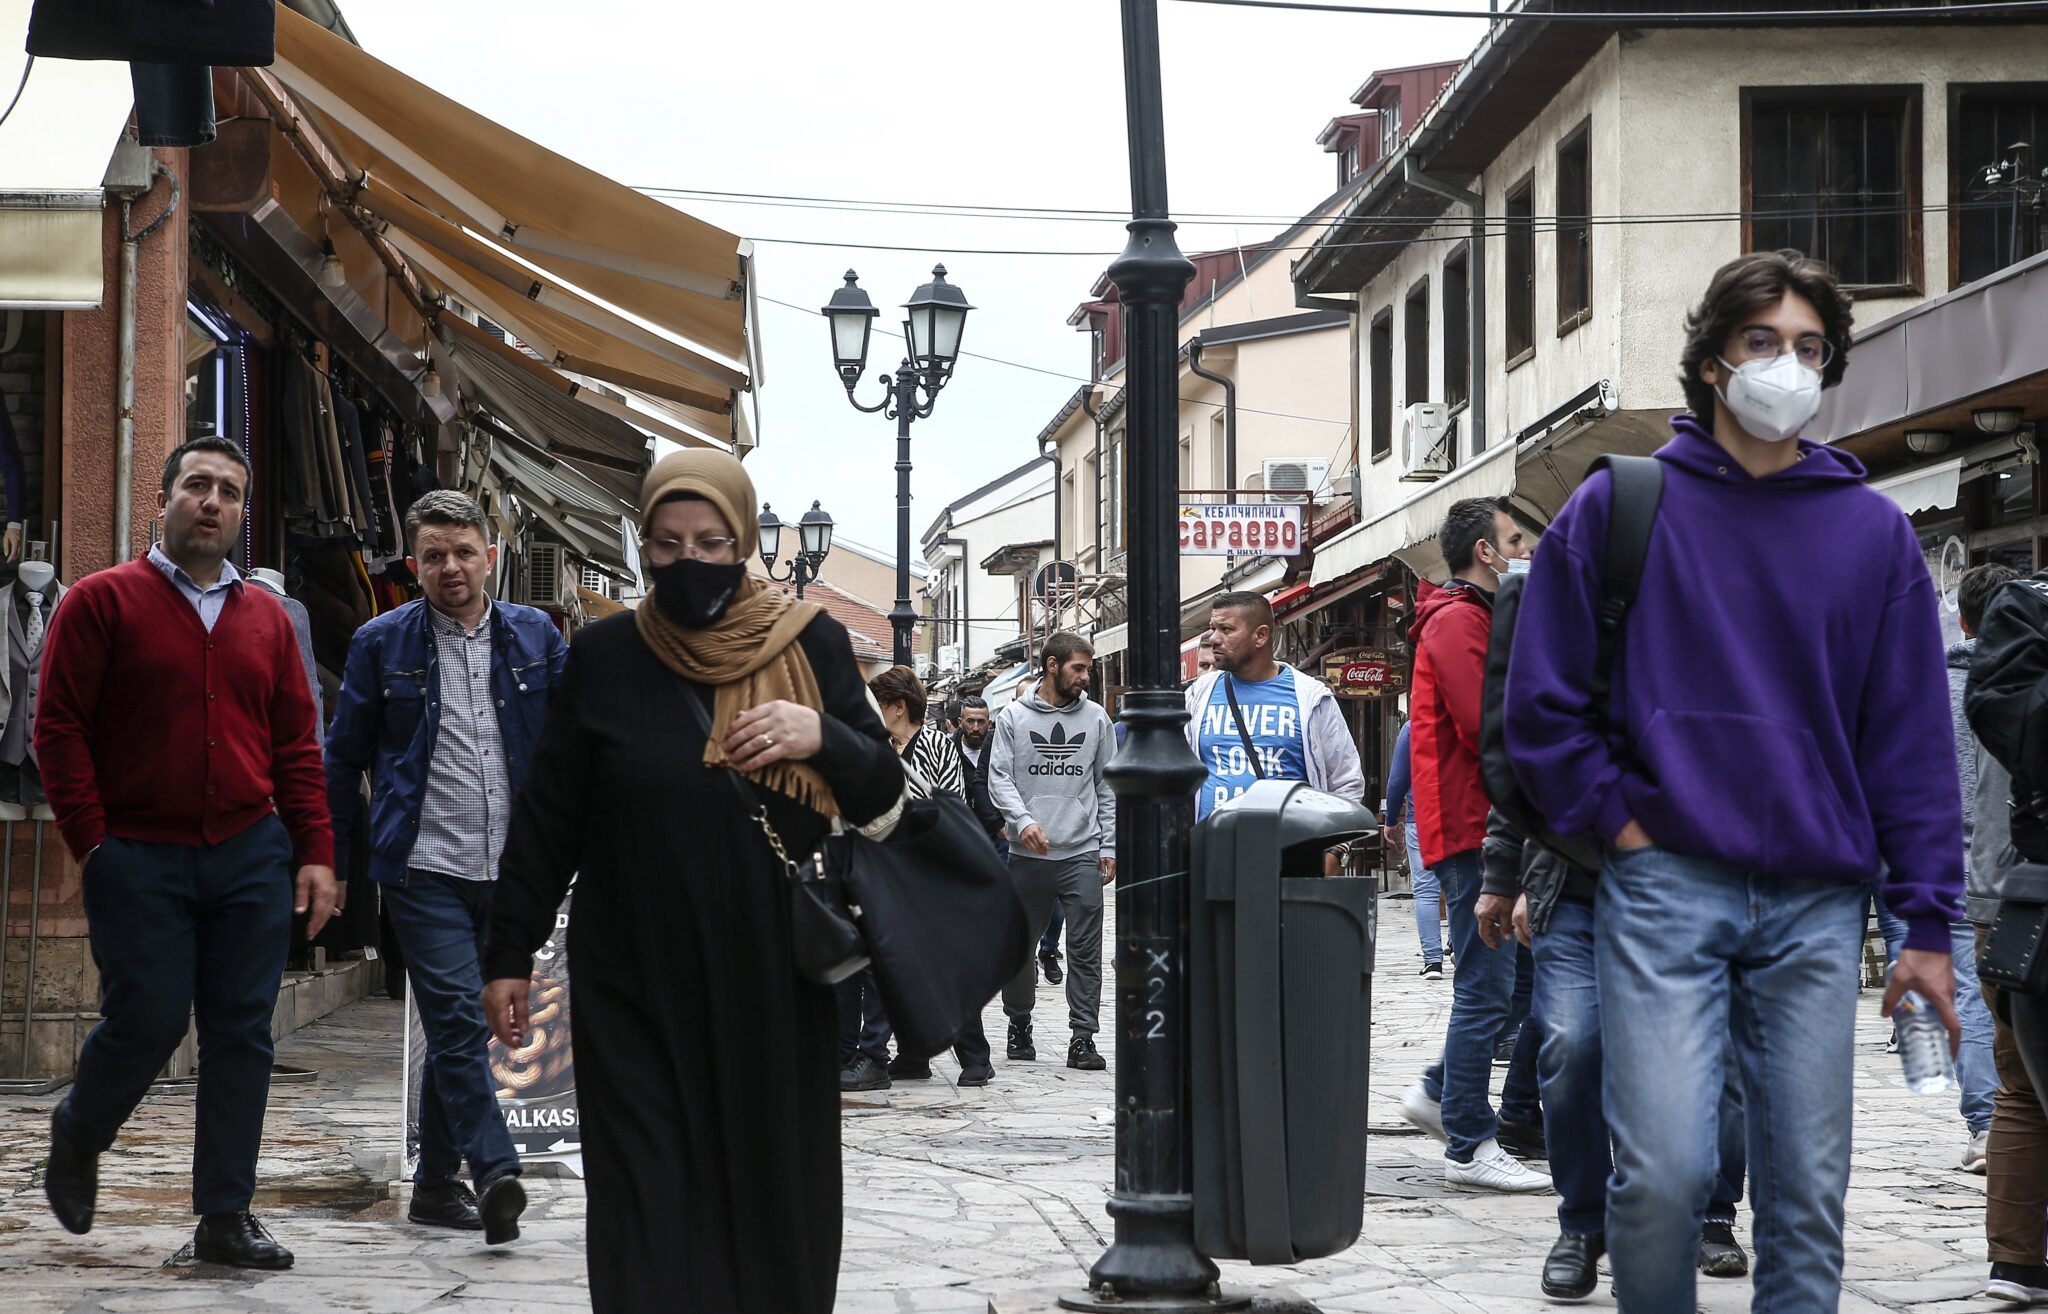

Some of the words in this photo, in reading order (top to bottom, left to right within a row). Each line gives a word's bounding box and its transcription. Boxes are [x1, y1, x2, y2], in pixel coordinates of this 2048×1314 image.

[1204, 506, 1285, 518] КЕБАПЧИЛНИЦА
[1204, 704, 1296, 737] NEVER
[1028, 761, 1084, 776] adidas
[1212, 745, 1286, 777] LOOK
